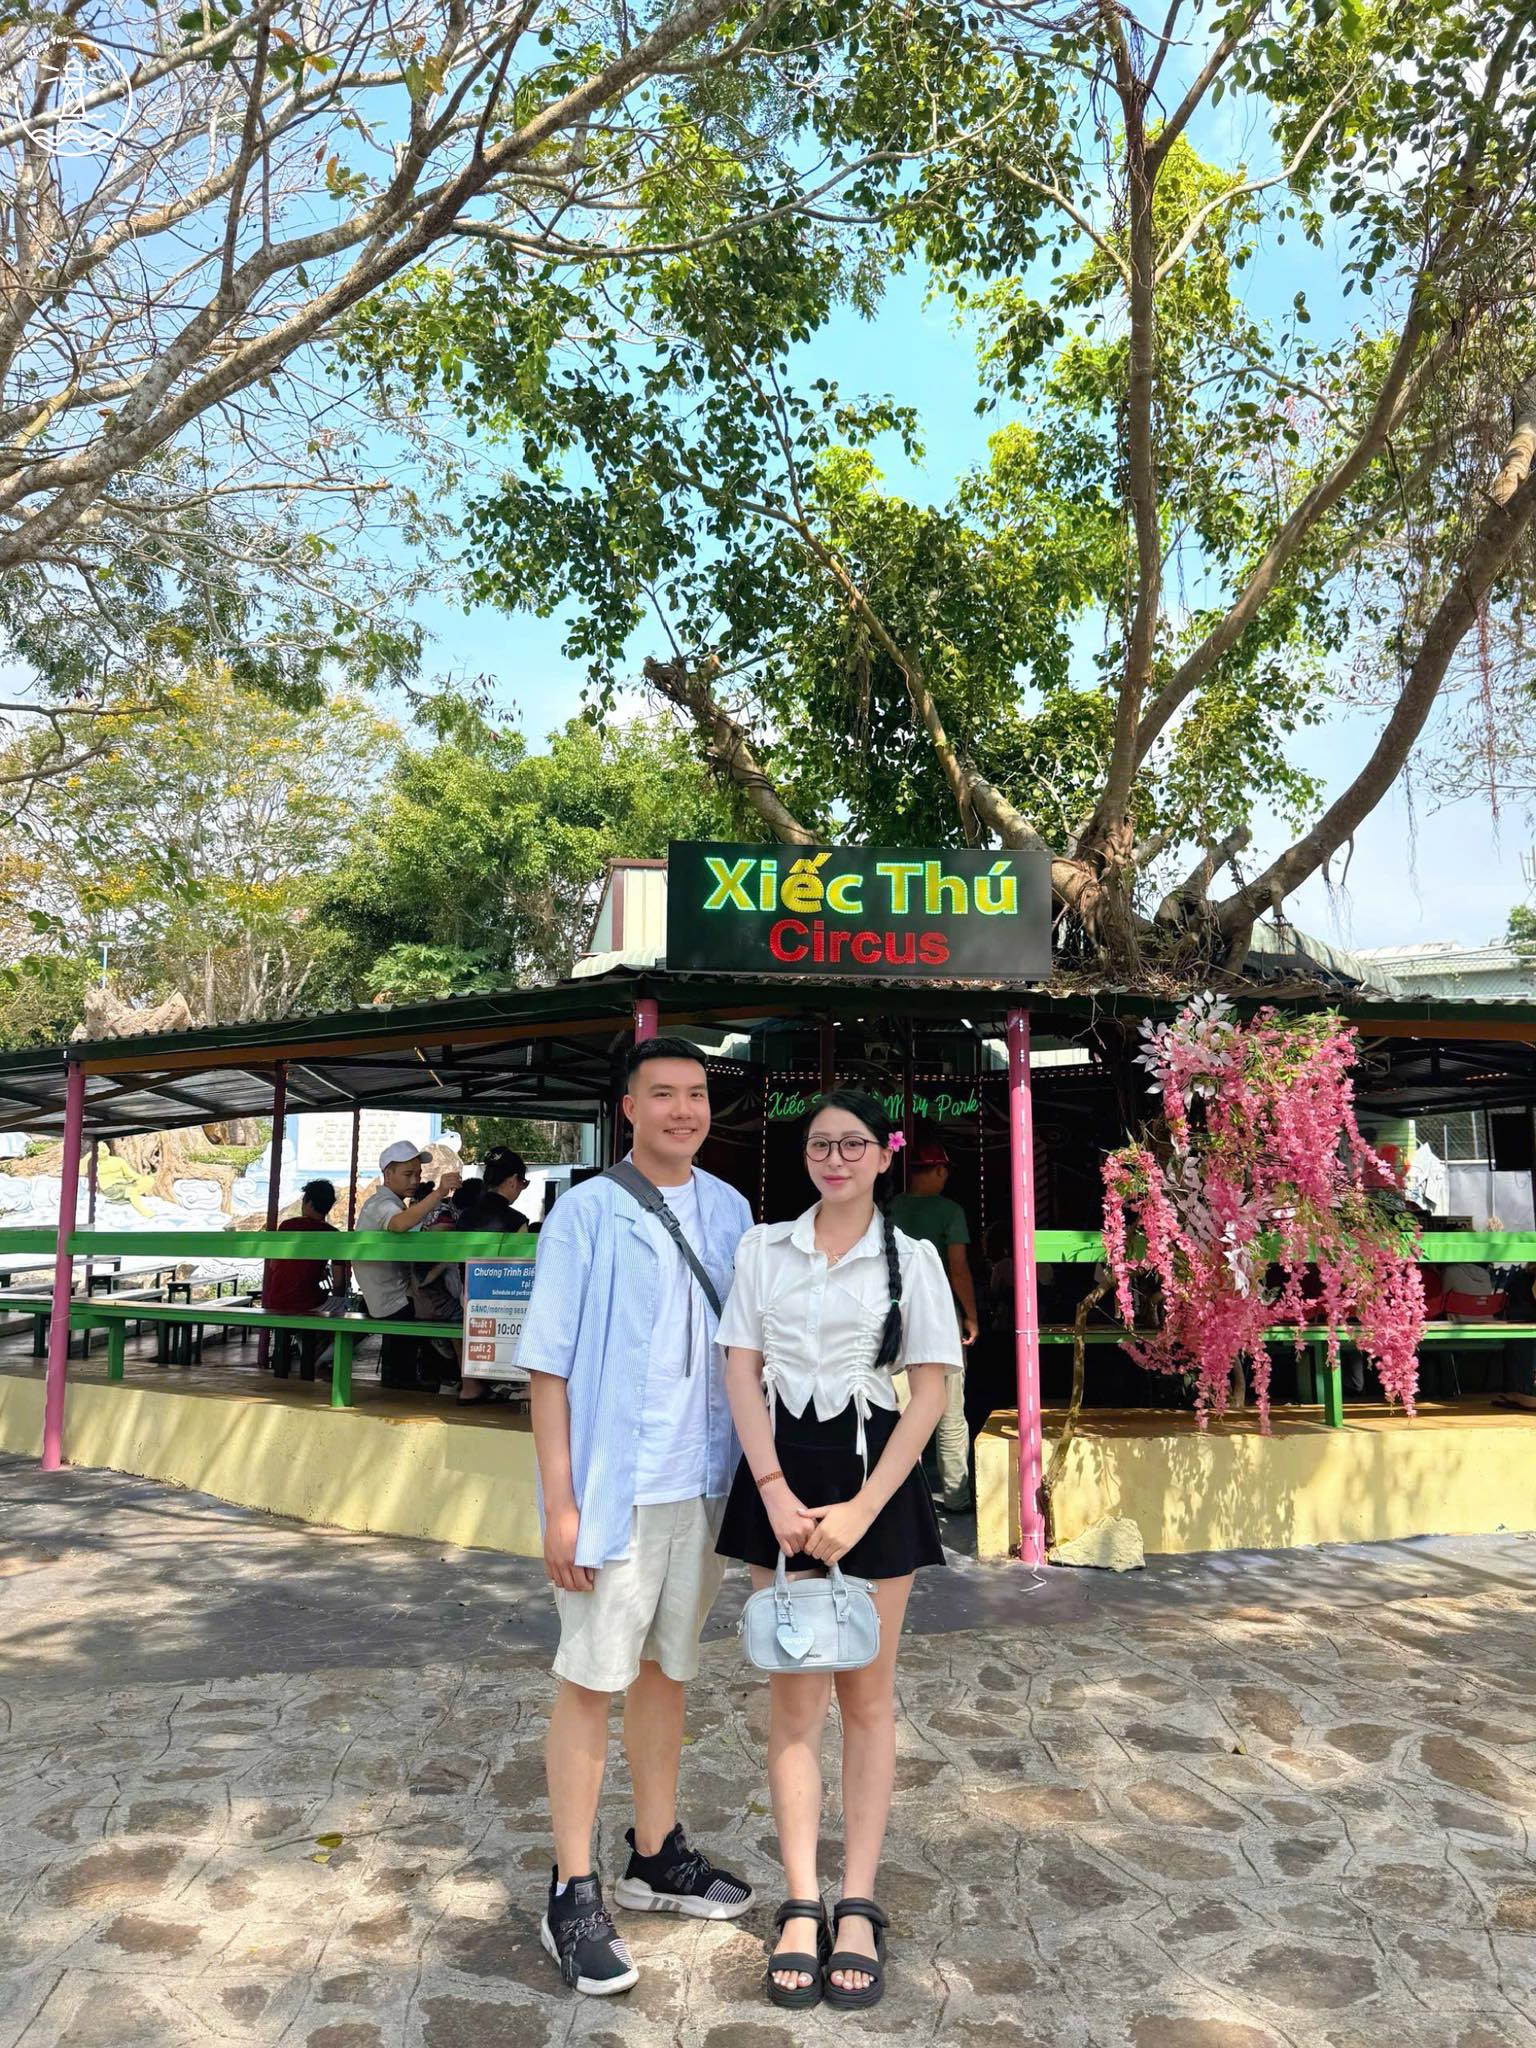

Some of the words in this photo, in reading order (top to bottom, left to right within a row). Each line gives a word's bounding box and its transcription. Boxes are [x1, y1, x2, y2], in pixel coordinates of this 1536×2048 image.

[703, 852, 864, 915] Xiếc
[876, 860, 1019, 915] Thú
[769, 919, 951, 966] Circus
[768, 1091, 806, 1119] Xiếc
[934, 1088, 979, 1121] Park
[474, 1267, 502, 1278] Chương
[503, 1267, 522, 1277] Trình
[488, 1320, 493, 1329] 1
[497, 1323, 522, 1336] 10:00
[486, 1344, 492, 1353] 2
